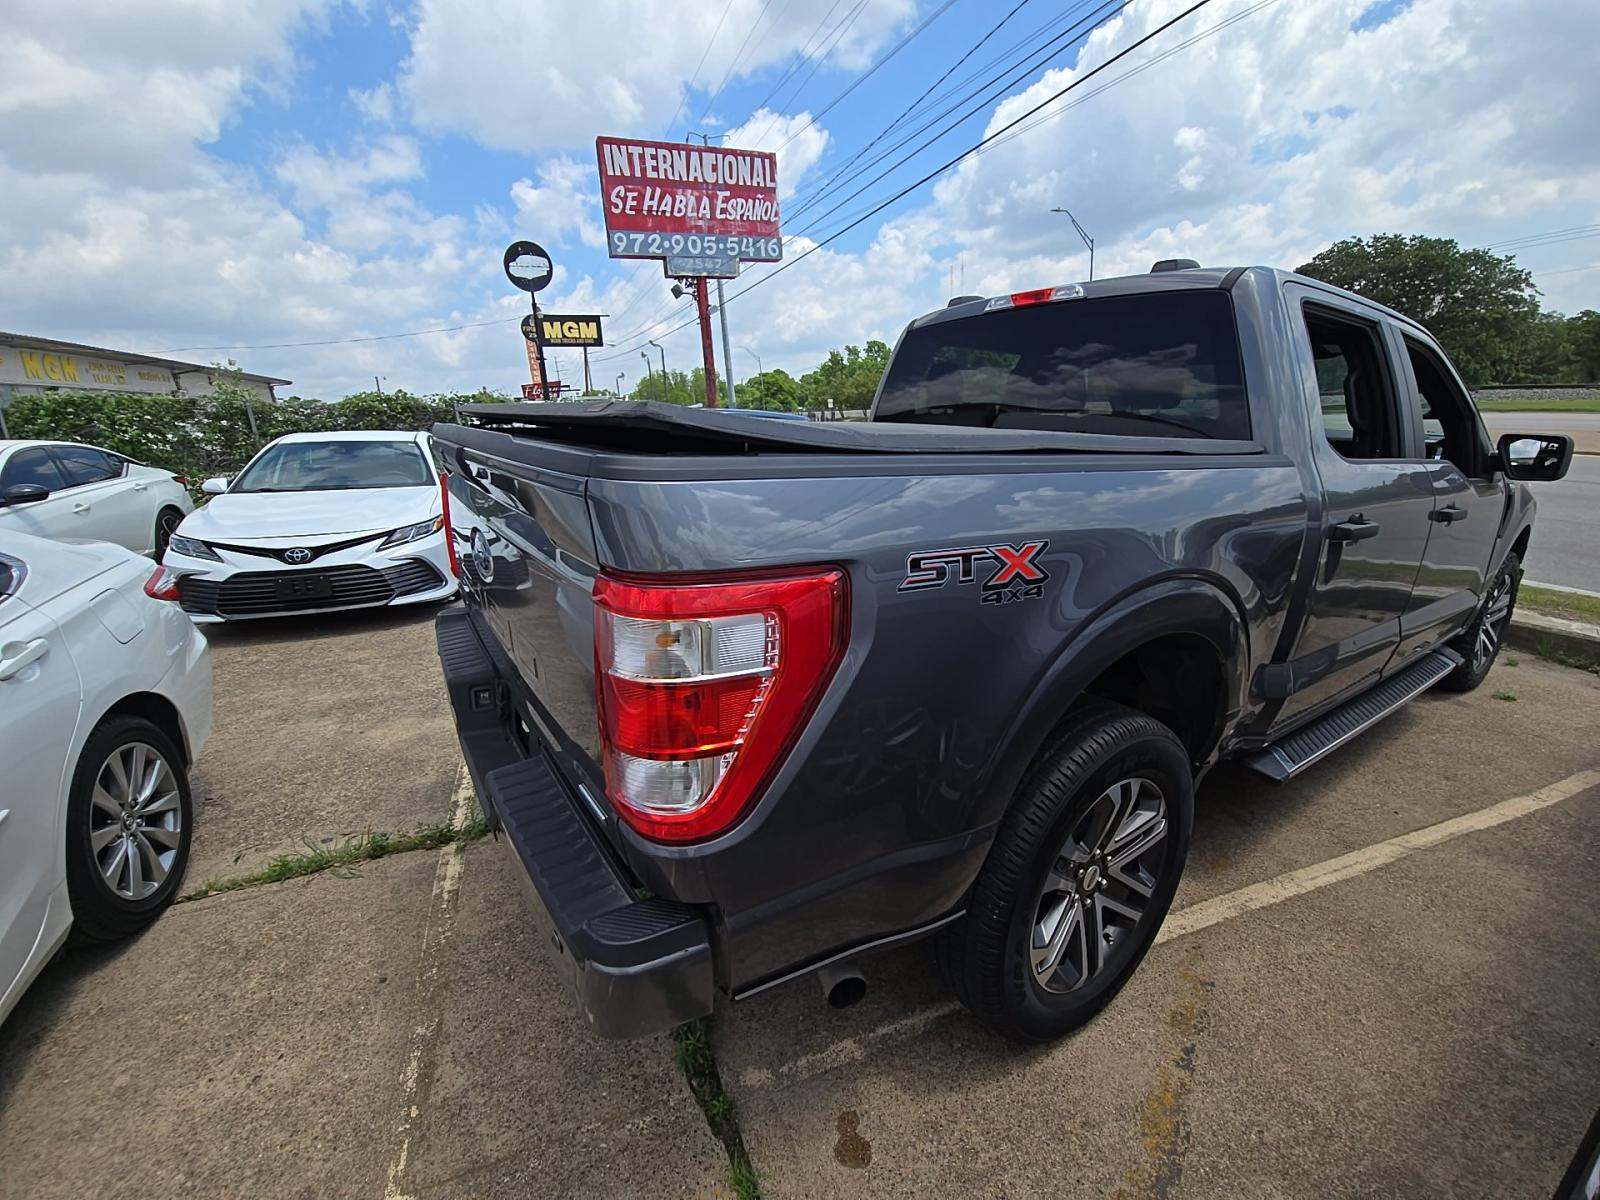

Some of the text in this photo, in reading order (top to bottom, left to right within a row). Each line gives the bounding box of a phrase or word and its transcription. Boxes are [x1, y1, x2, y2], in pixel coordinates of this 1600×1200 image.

[603, 144, 777, 188] INTERNACIONAL
[610, 185, 780, 222] SE HABLA ESPAÑOL
[543, 321, 597, 338] MGM
[21, 351, 81, 382] MGM
[897, 539, 1051, 593] STX
